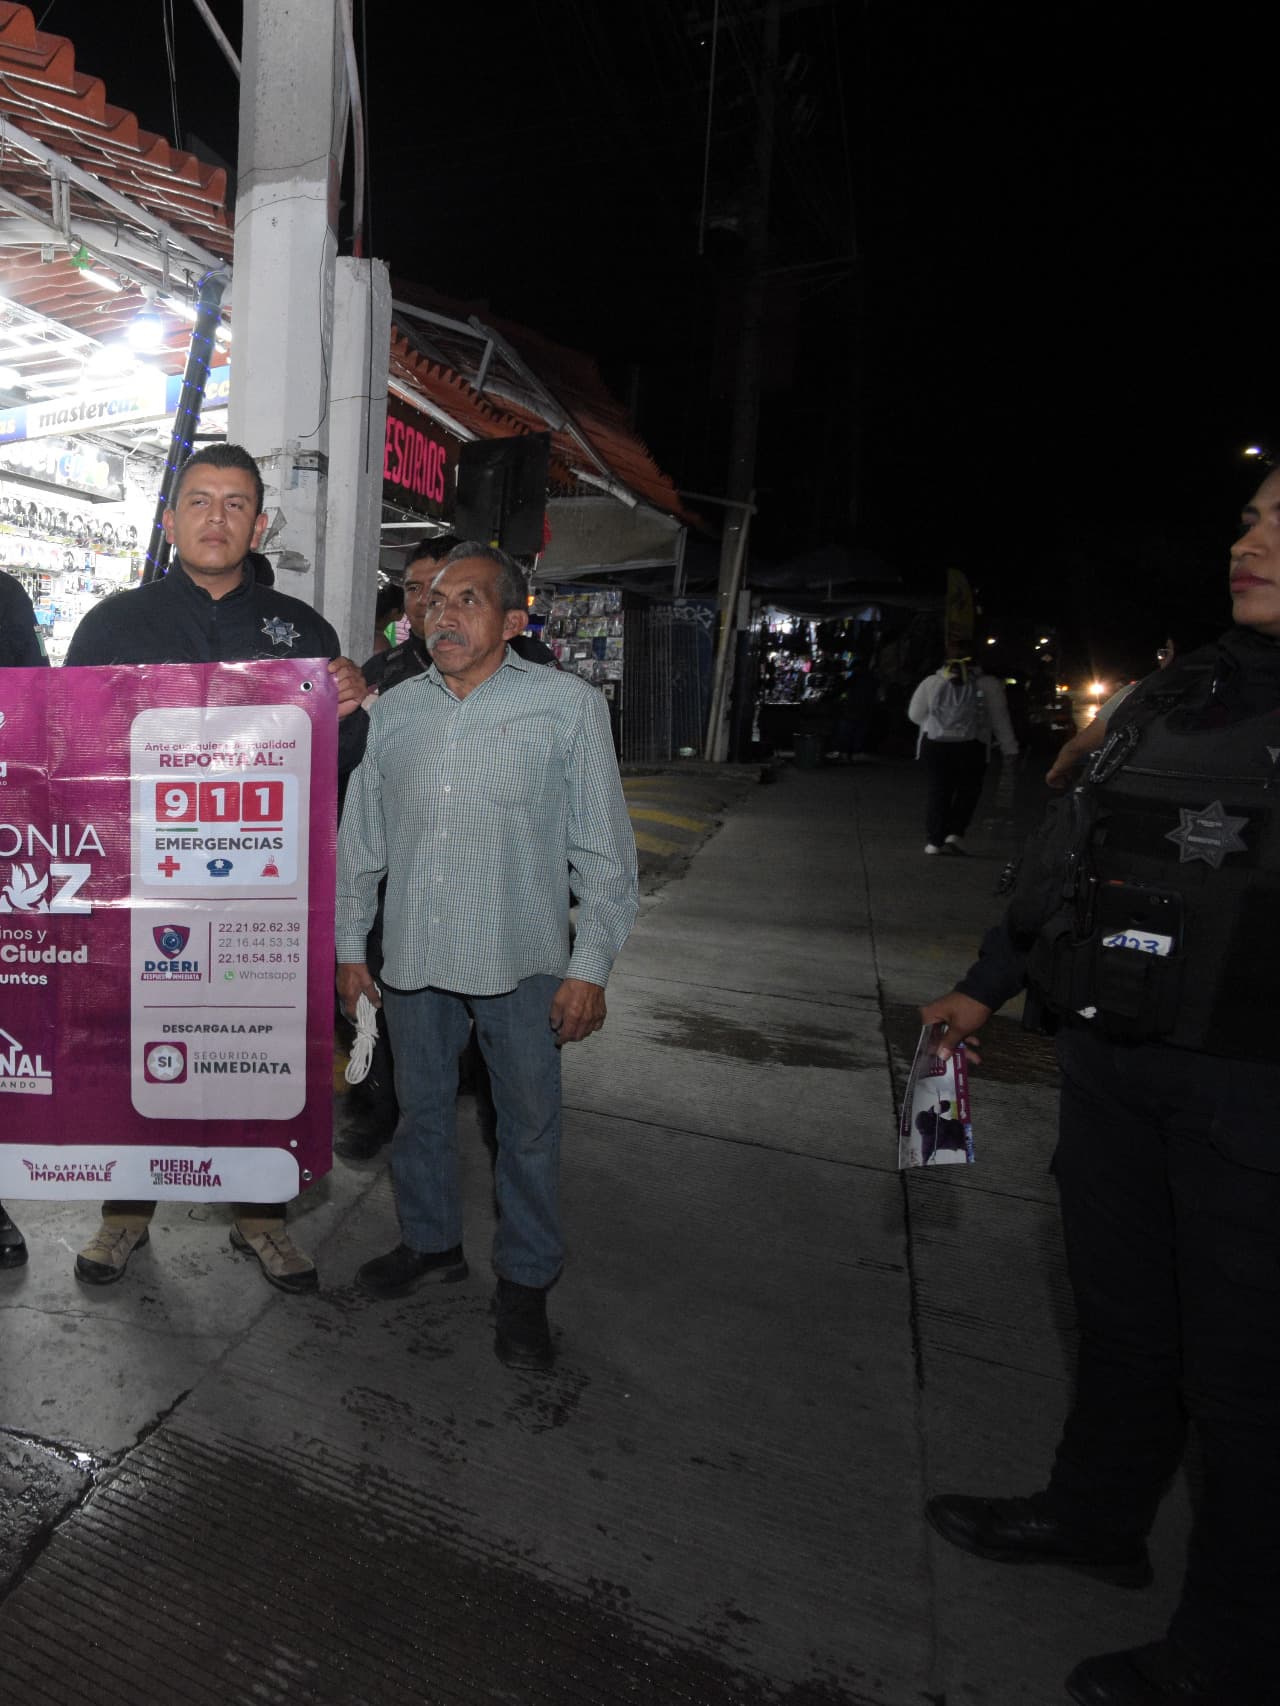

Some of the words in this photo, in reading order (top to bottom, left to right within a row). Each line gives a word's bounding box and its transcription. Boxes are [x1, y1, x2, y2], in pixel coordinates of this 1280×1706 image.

[253, 751, 284, 767] AL:
[155, 837, 284, 851] EMERGENCIAS
[218, 922, 301, 934] 22.21.92.62.39
[36, 929, 47, 944] y
[0, 944, 88, 964] Ciudad
[144, 960, 199, 973] DGERI
[239, 970, 297, 983] Whatsapp
[162, 1024, 229, 1034] DESCARGA
[231, 1024, 248, 1034] LA
[250, 1024, 273, 1034] APP
[157, 1056, 172, 1069] SI
[193, 1051, 269, 1061] SEGURIDAD
[194, 1061, 292, 1075] INMEDIATA
[35, 1163, 49, 1171] LA
[54, 1163, 105, 1171] CAPITAL
[149, 1158, 213, 1174] PUEBLA
[30, 1171, 112, 1183] IMPARABLE
[164, 1174, 222, 1187] SEGURA
